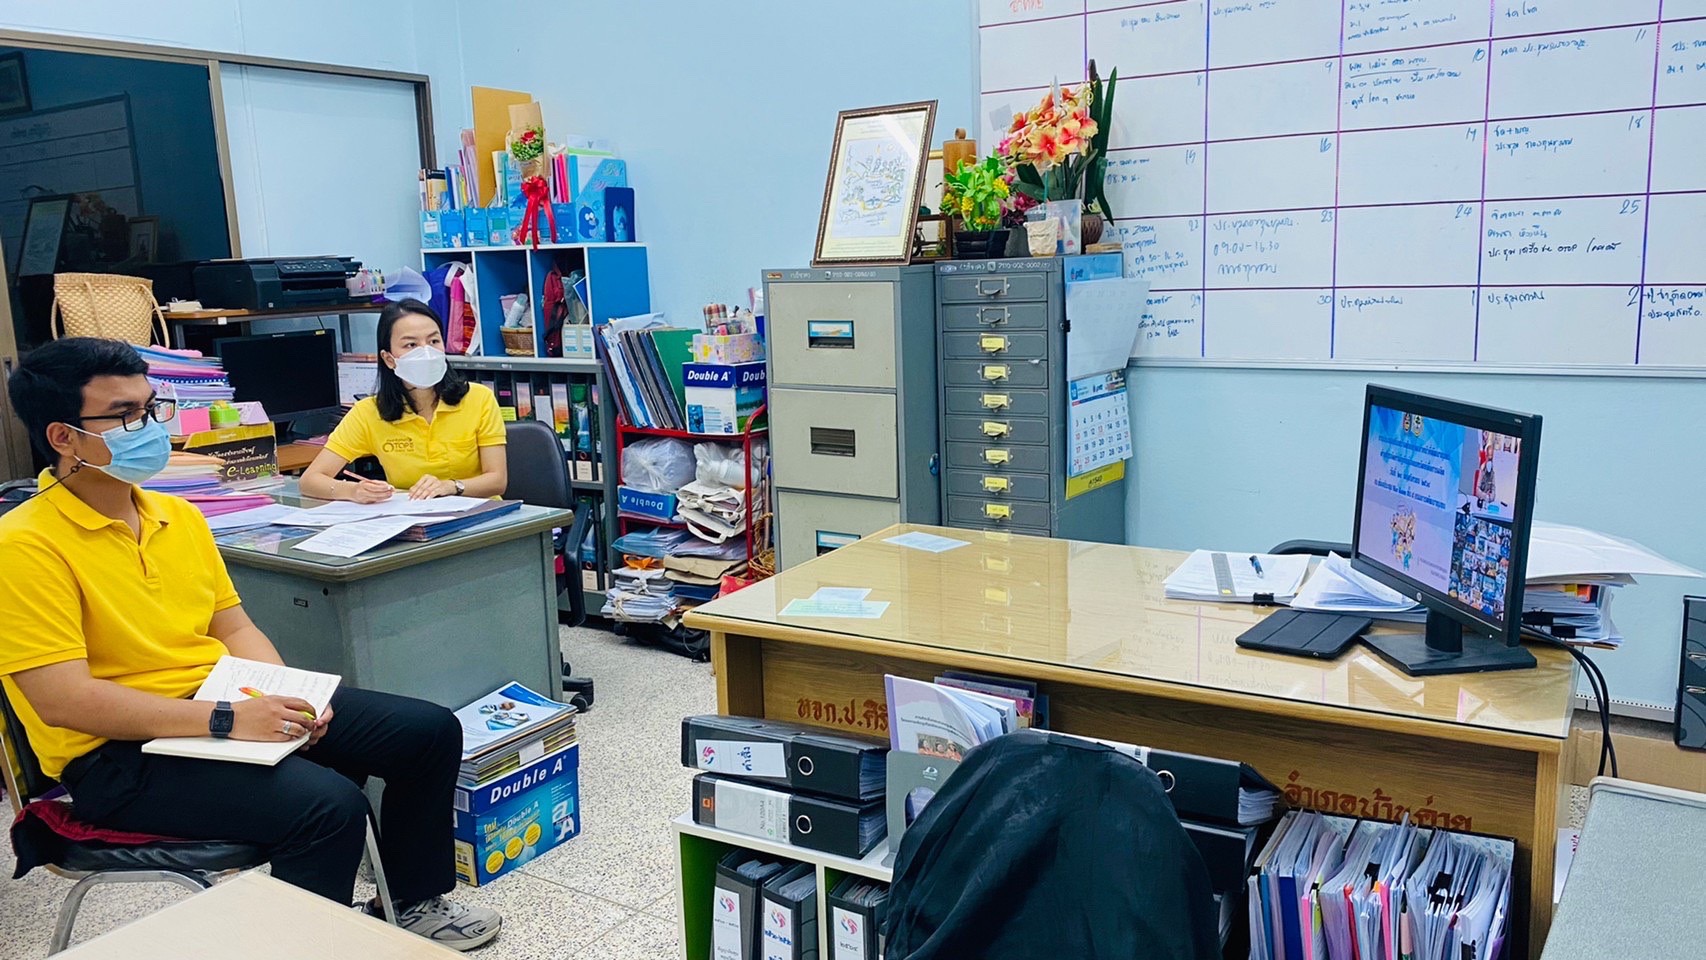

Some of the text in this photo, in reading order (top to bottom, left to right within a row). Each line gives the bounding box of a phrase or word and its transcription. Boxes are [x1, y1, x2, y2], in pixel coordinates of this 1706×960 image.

[1628, 115, 1644, 131] 18
[1455, 204, 1472, 219] 24
[1619, 199, 1642, 215] 25
[1320, 209, 1333, 223] 23
[1317, 295, 1331, 304] 30
[1627, 285, 1640, 307] 2
[687, 370, 729, 381] Double A
[742, 371, 766, 382] Doub
[621, 495, 663, 510] Double A
[490, 768, 547, 804] Double
[552, 758, 563, 775] A
